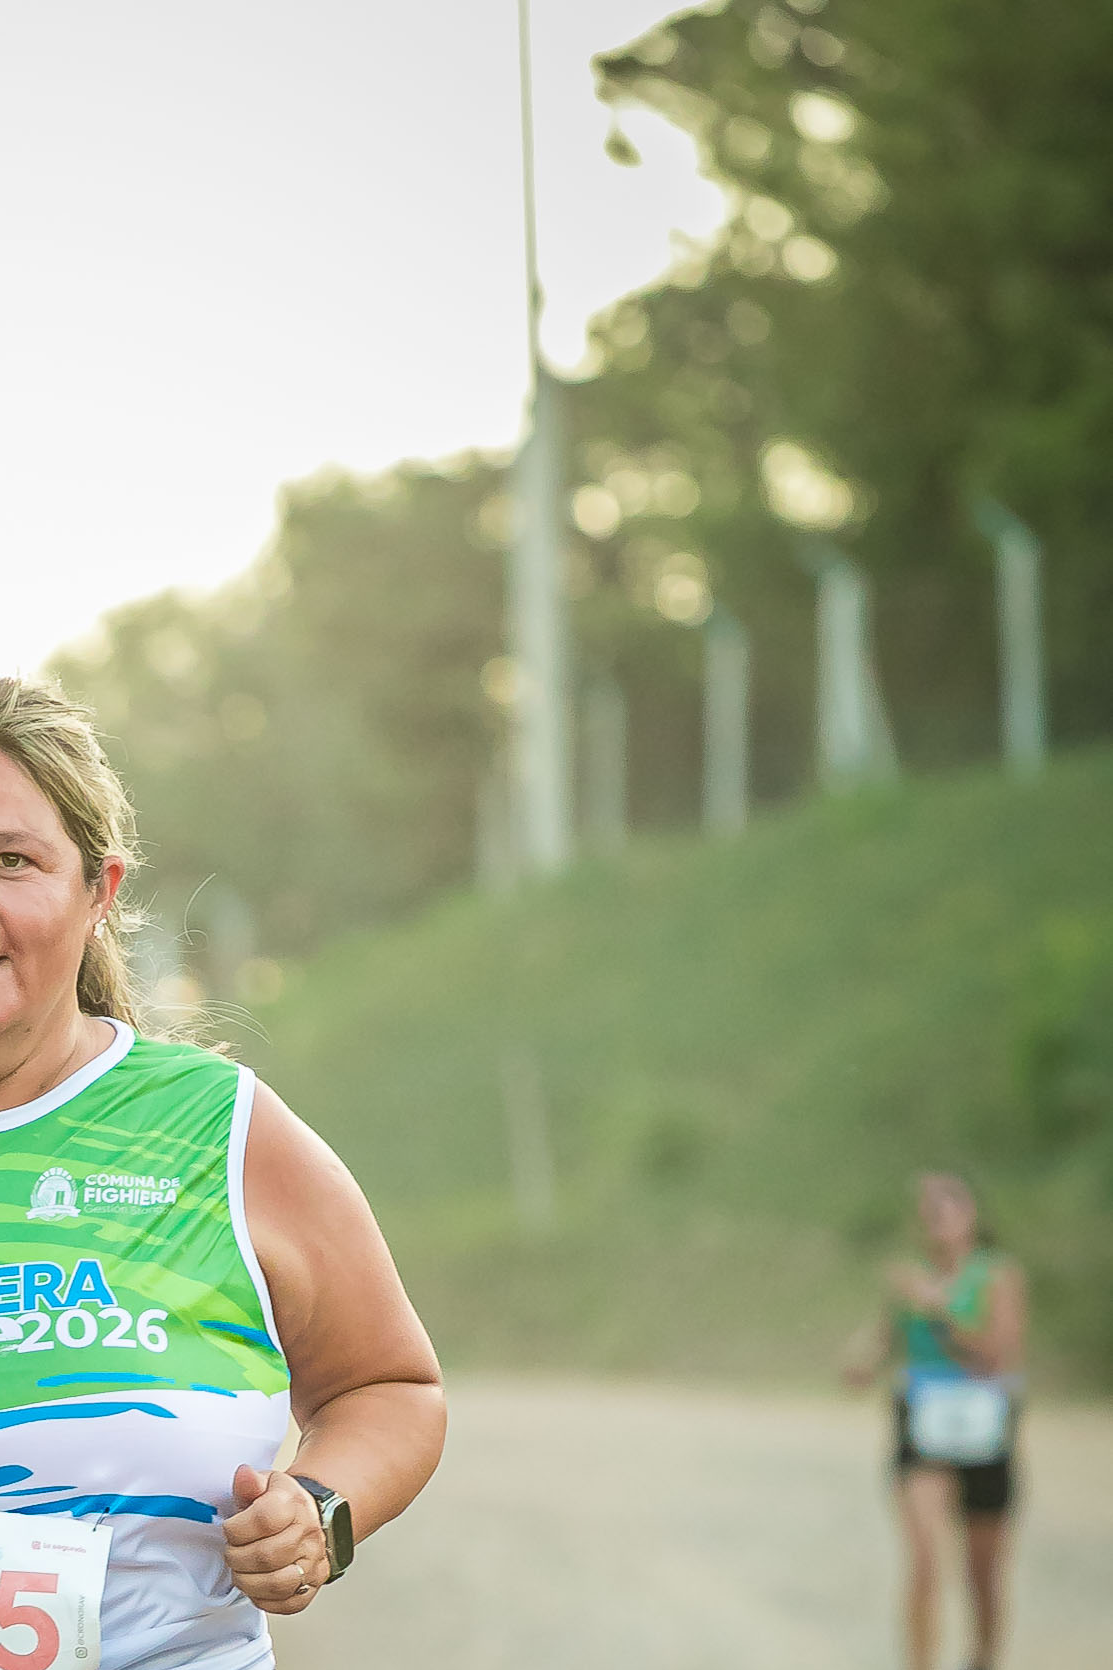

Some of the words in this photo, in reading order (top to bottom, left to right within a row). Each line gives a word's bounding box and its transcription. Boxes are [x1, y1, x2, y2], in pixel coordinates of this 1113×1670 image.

[85, 1173, 156, 1188] COMUNA
[159, 1177, 180, 1189] DE
[83, 1187, 177, 1206] FIGHIERA
